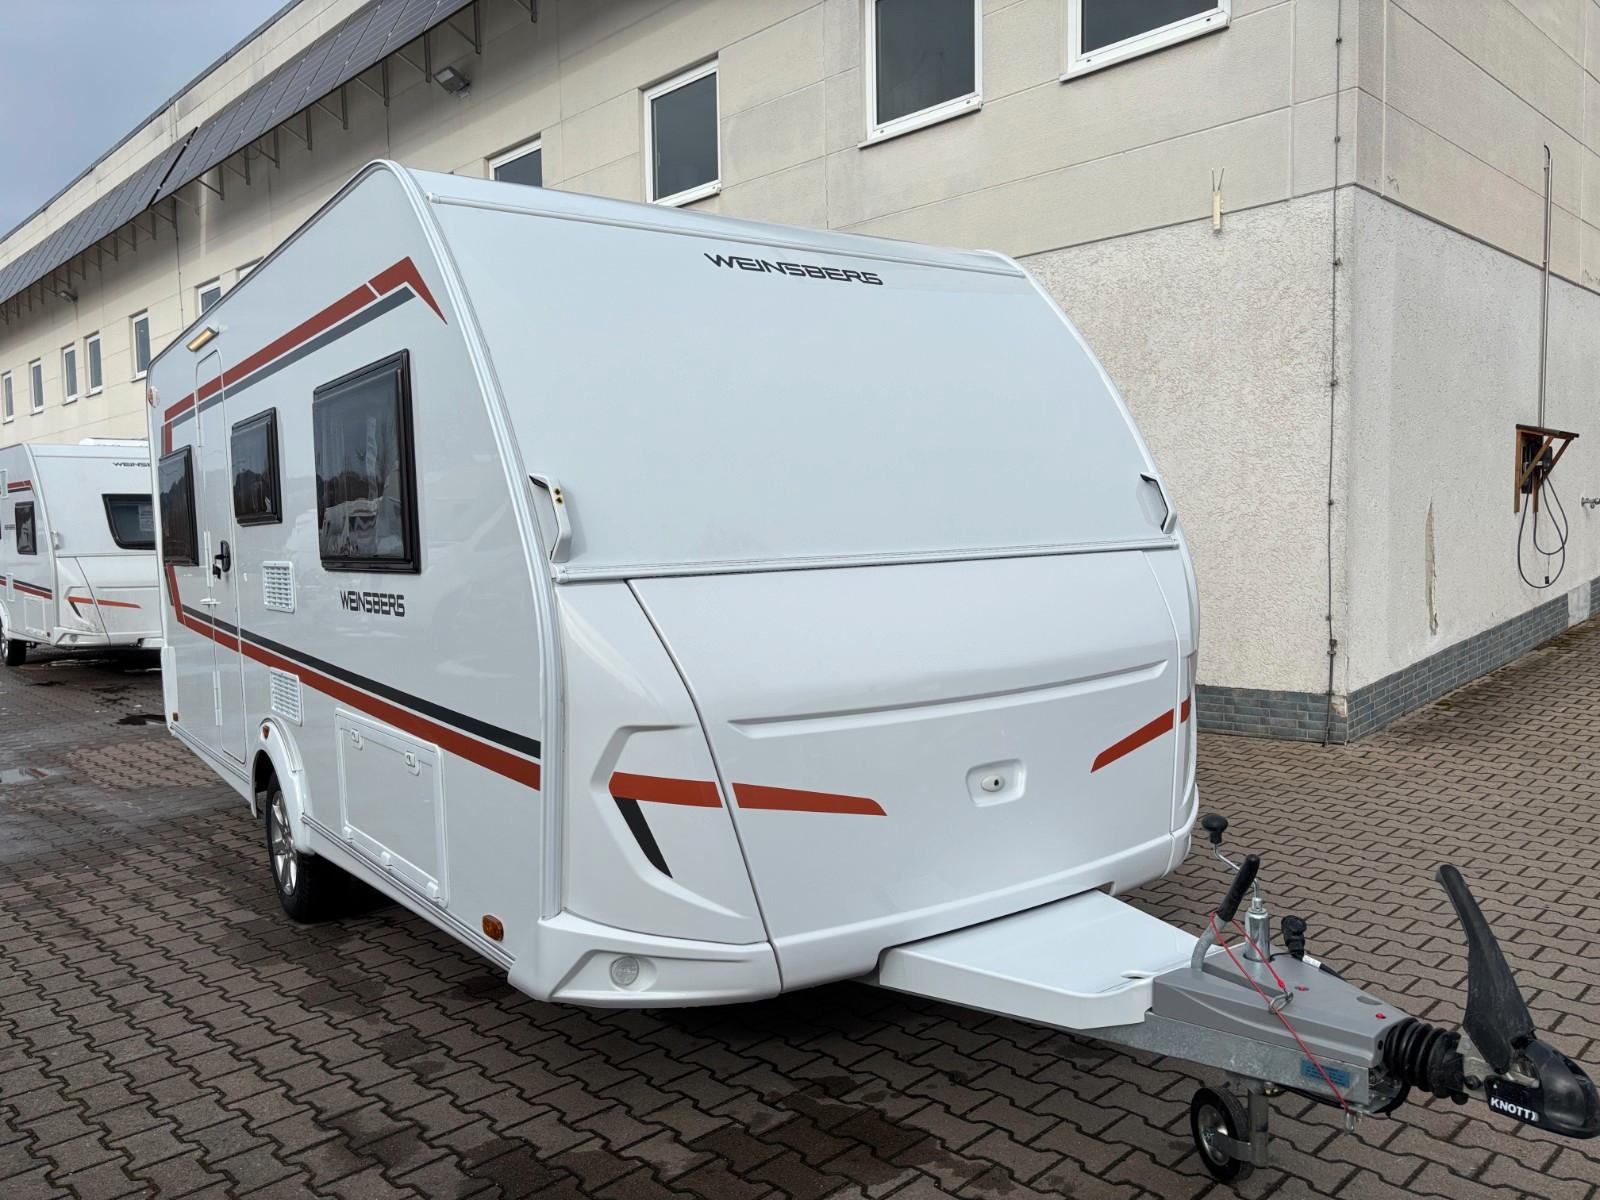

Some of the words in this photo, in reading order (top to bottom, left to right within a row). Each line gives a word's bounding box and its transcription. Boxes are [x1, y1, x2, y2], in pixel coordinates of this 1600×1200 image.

[704, 253, 883, 285] WEINSBERG
[340, 590, 405, 617] WEINSBERG
[1491, 1097, 1534, 1119] KNOTT
